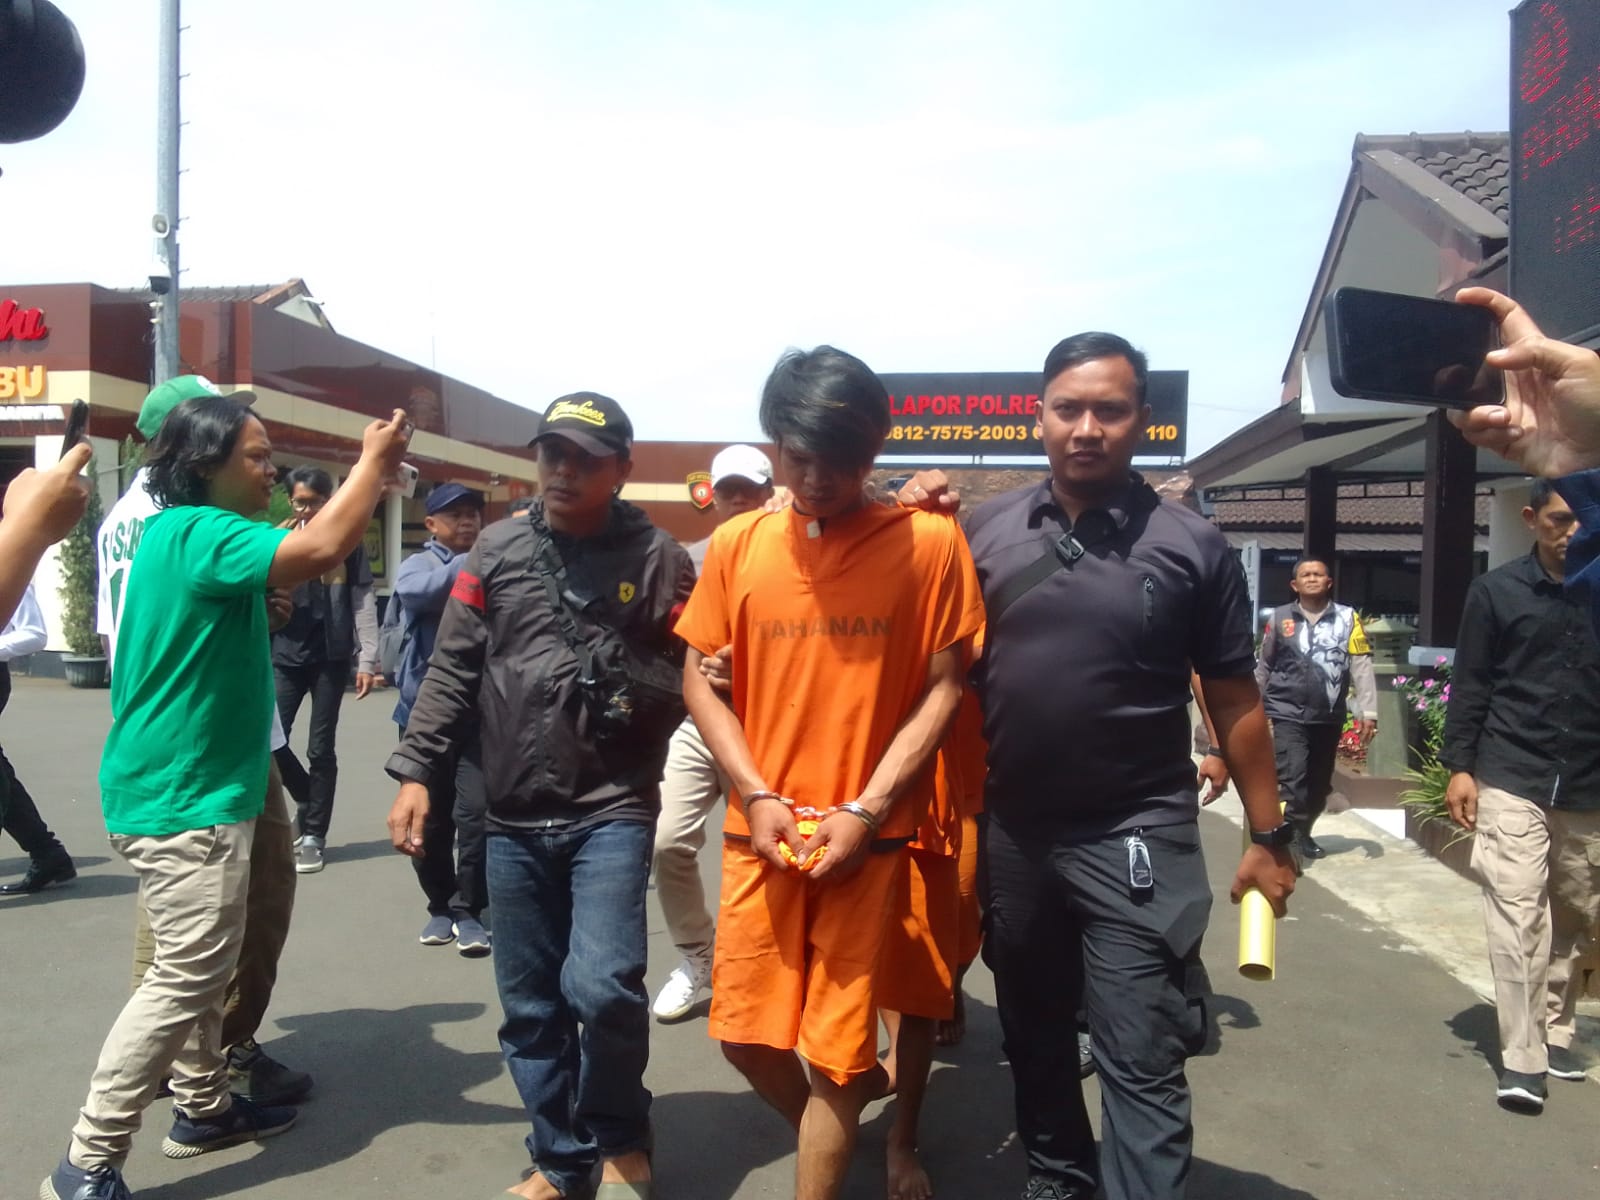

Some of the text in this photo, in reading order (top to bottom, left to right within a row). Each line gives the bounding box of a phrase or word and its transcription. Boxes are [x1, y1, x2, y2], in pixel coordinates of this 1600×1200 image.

[889, 394, 1038, 416] LAPOR POLRE
[1146, 424, 1178, 441] 110
[756, 616, 891, 640] TAHANAN
